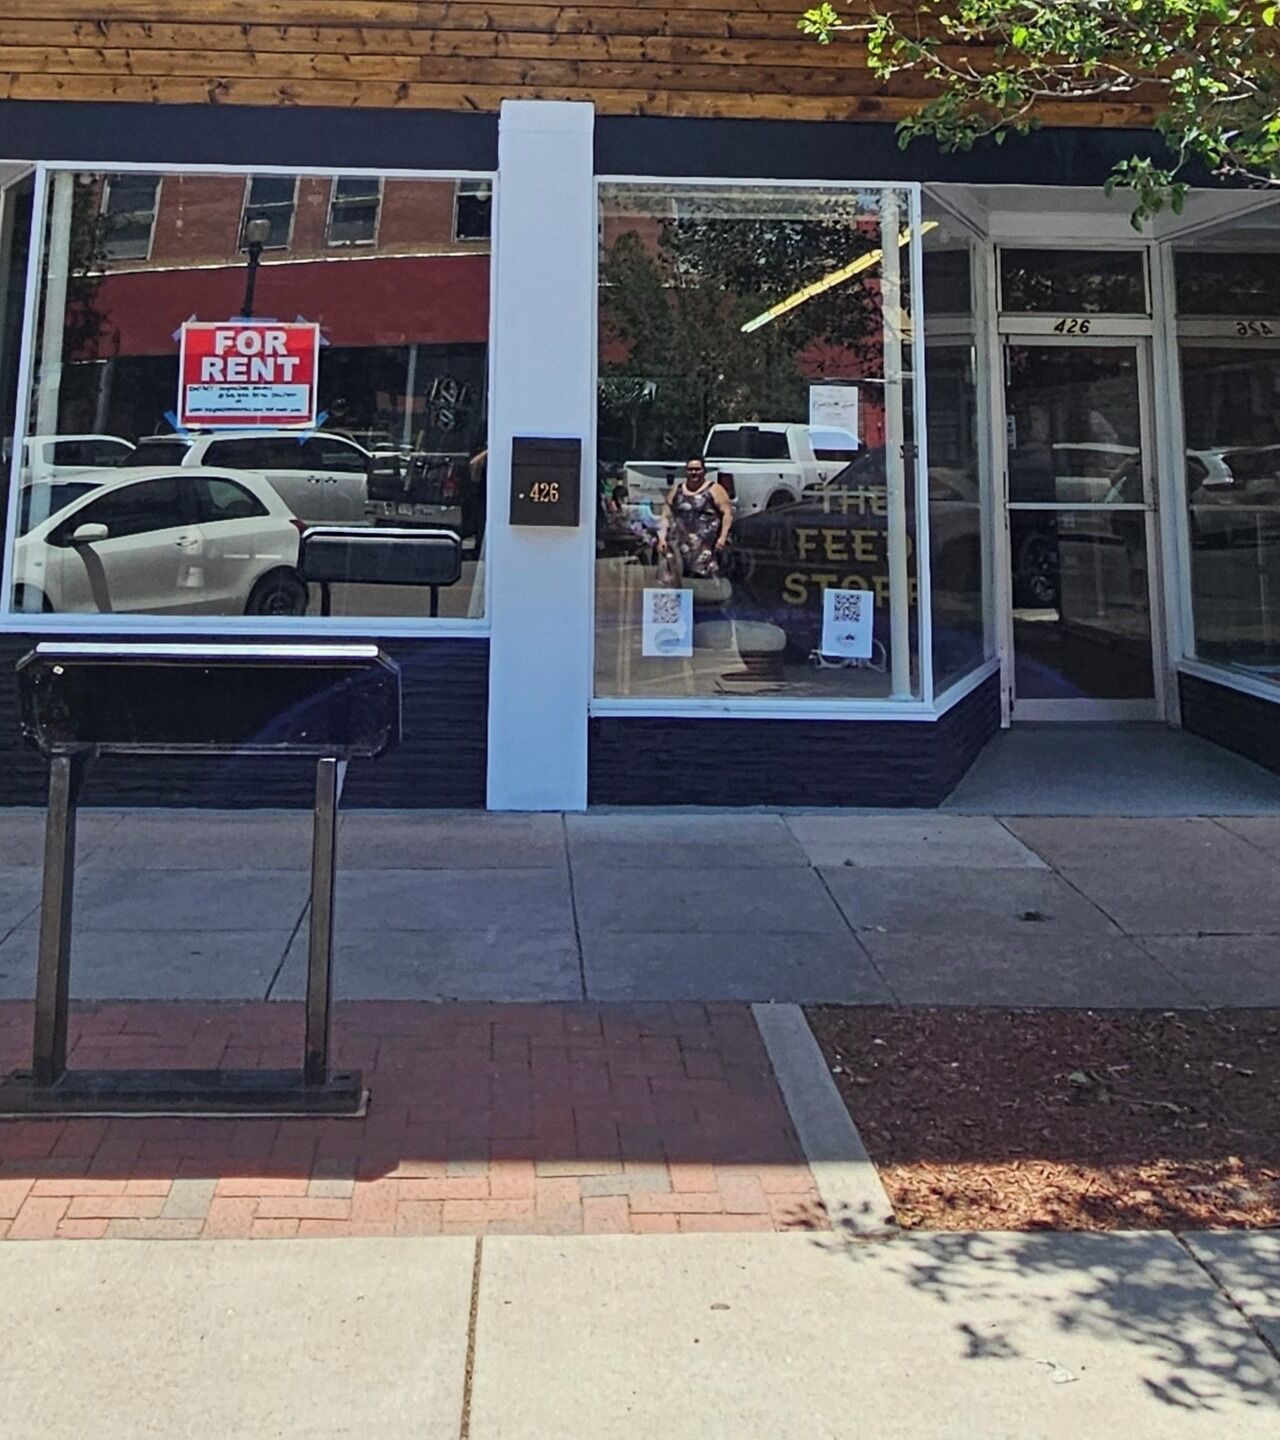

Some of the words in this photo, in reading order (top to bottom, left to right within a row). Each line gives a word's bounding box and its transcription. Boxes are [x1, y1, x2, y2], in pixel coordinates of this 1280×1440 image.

[1054, 319, 1091, 334] 426
[215, 330, 288, 356] FOR
[201, 357, 300, 382] RENT
[529, 482, 559, 502] 426
[815, 484, 889, 516] THE
